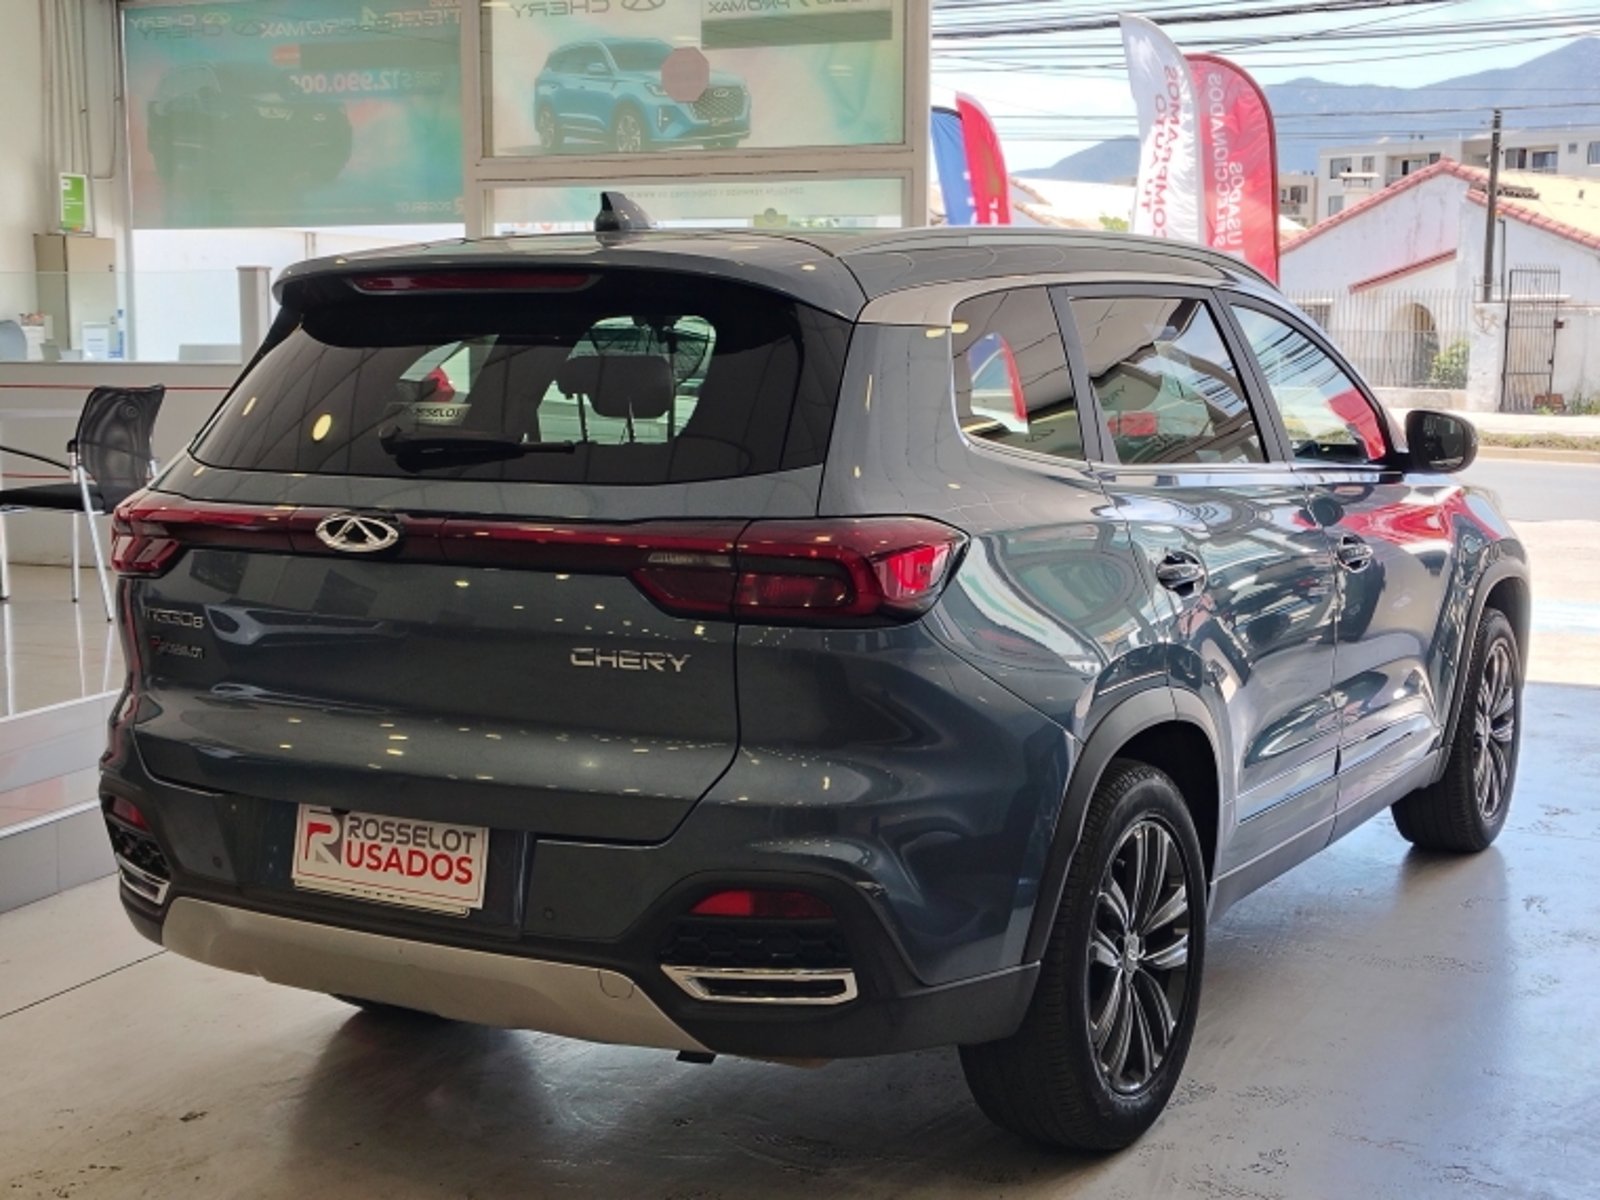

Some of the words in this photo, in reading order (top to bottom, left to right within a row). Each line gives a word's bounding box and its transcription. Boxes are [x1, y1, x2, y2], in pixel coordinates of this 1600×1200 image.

[570, 647, 692, 673] CHERY
[347, 816, 477, 855] ROSSELOT
[345, 840, 473, 886] USADOS
